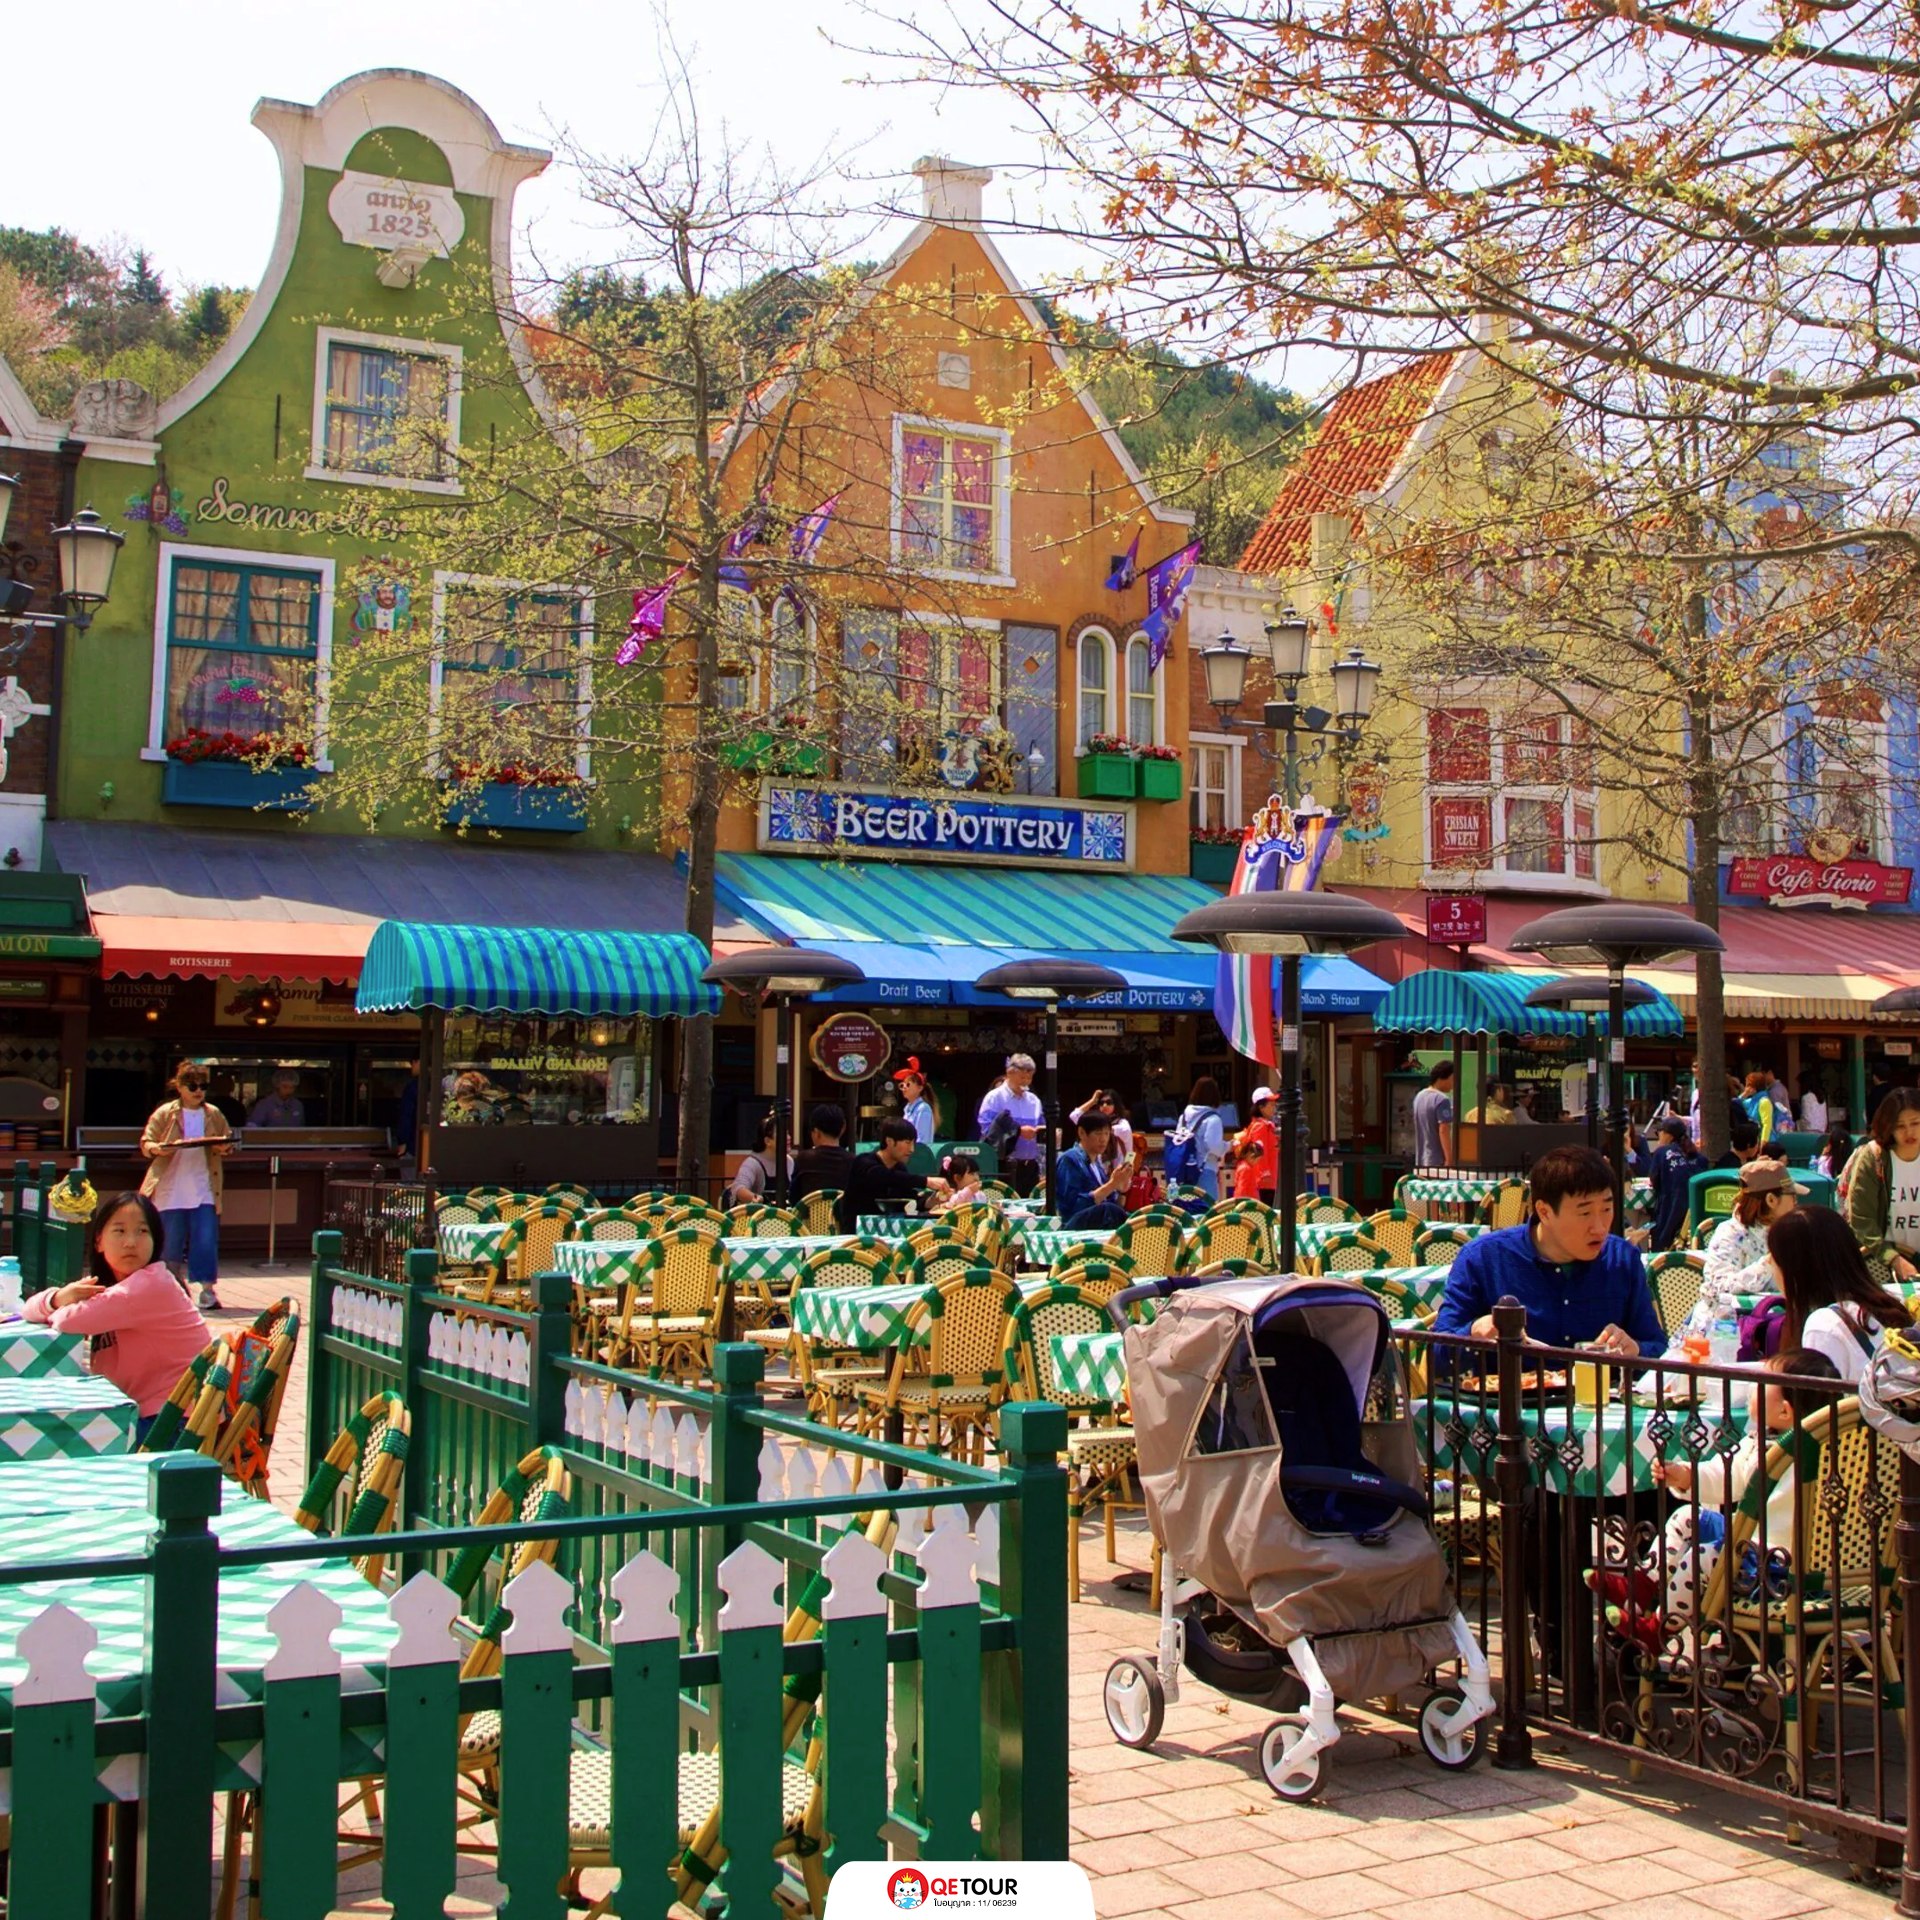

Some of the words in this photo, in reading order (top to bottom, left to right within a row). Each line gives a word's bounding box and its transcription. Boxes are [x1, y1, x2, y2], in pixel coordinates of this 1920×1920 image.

[367, 213, 431, 239] 1825
[834, 798, 927, 842] BEER
[935, 807, 1075, 851] POTTERY
[1768, 863, 1814, 894] Café
[1818, 866, 1877, 893] Fiorio
[1450, 902, 1461, 919] 5
[169, 957, 232, 967] ROTISSERIE
[104, 983, 176, 996] ROTISSERIE
[879, 983, 909, 997] Draft
[915, 984, 941, 998] Beer
[1128, 989, 1186, 1005] POTTERY
[109, 996, 168, 1008] CHICN
[1301, 992, 1325, 1005] lland
[1331, 993, 1360, 1006] Straat
[1717, 1192, 1736, 1201] PUS
